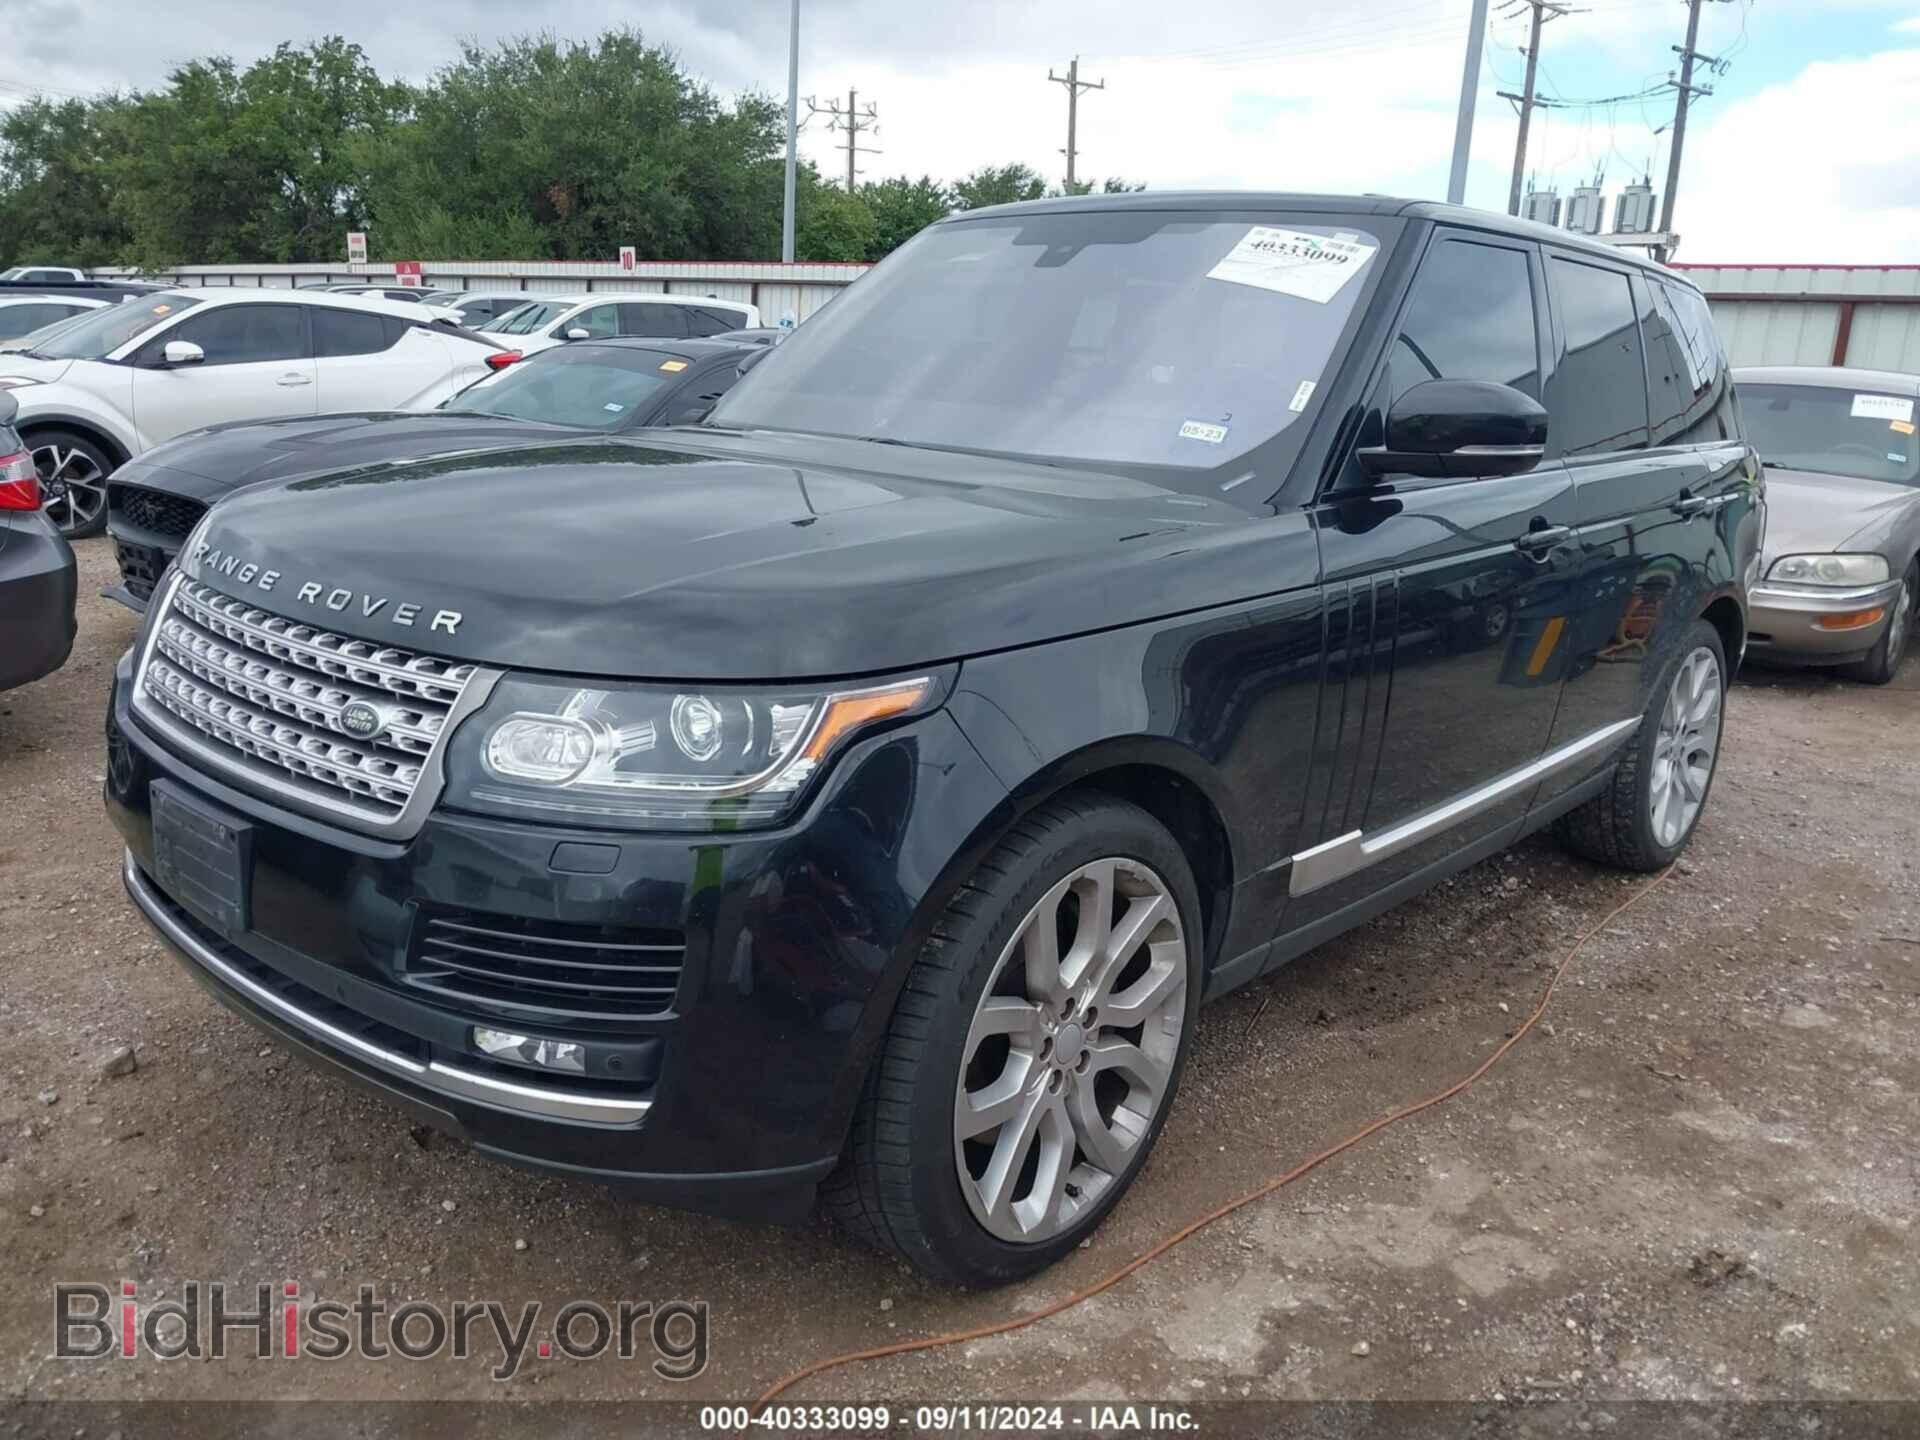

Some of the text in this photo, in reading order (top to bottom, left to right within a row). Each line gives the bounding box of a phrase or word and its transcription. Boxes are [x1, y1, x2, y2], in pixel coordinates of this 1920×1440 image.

[622, 251, 632, 270] 10
[1250, 239, 1349, 264] 40333099
[194, 542, 462, 634] RANGE ROVER
